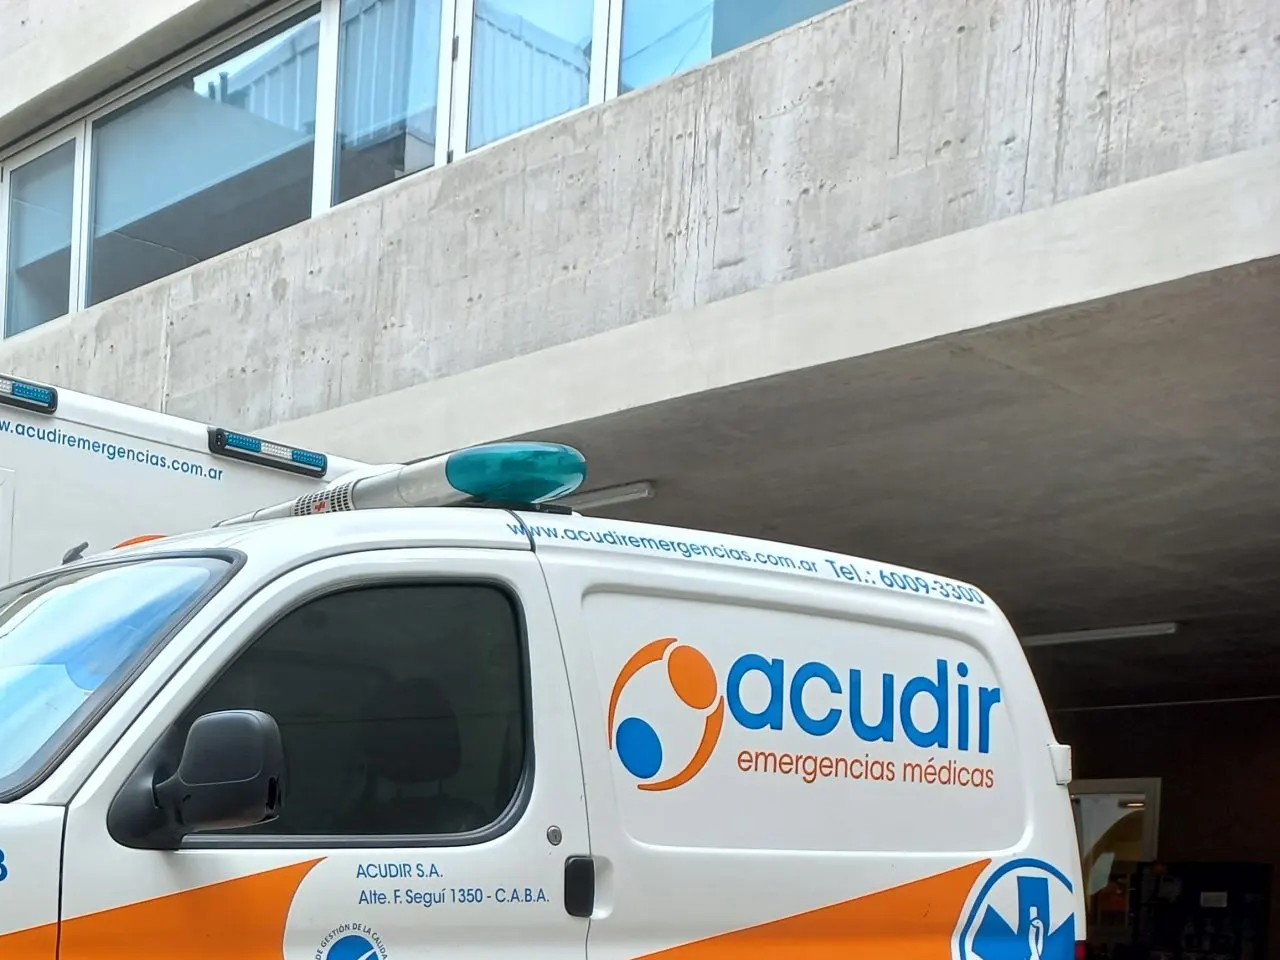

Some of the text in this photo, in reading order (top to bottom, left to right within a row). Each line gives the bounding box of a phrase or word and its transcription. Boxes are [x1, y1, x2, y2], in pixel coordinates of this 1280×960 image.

[505, 521, 986, 606] www.acudiremergencias.com.ar Tel.: 6009-3300
[726, 653, 1001, 754] acudir
[737, 749, 995, 789] emergencias médicas
[356, 863, 444, 879] ACUDIR S.A.
[358, 890, 391, 905] Alte.
[393, 889, 403, 904] F.
[405, 888, 446, 908] Seguí
[450, 888, 484, 904] 1350
[494, 888, 550, 903] C.A.B.A.
[315, 949, 324, 960] DE
[321, 922, 351, 948] GESTIÓN
[352, 923, 362, 931] DE
[363, 925, 372, 936] LA
